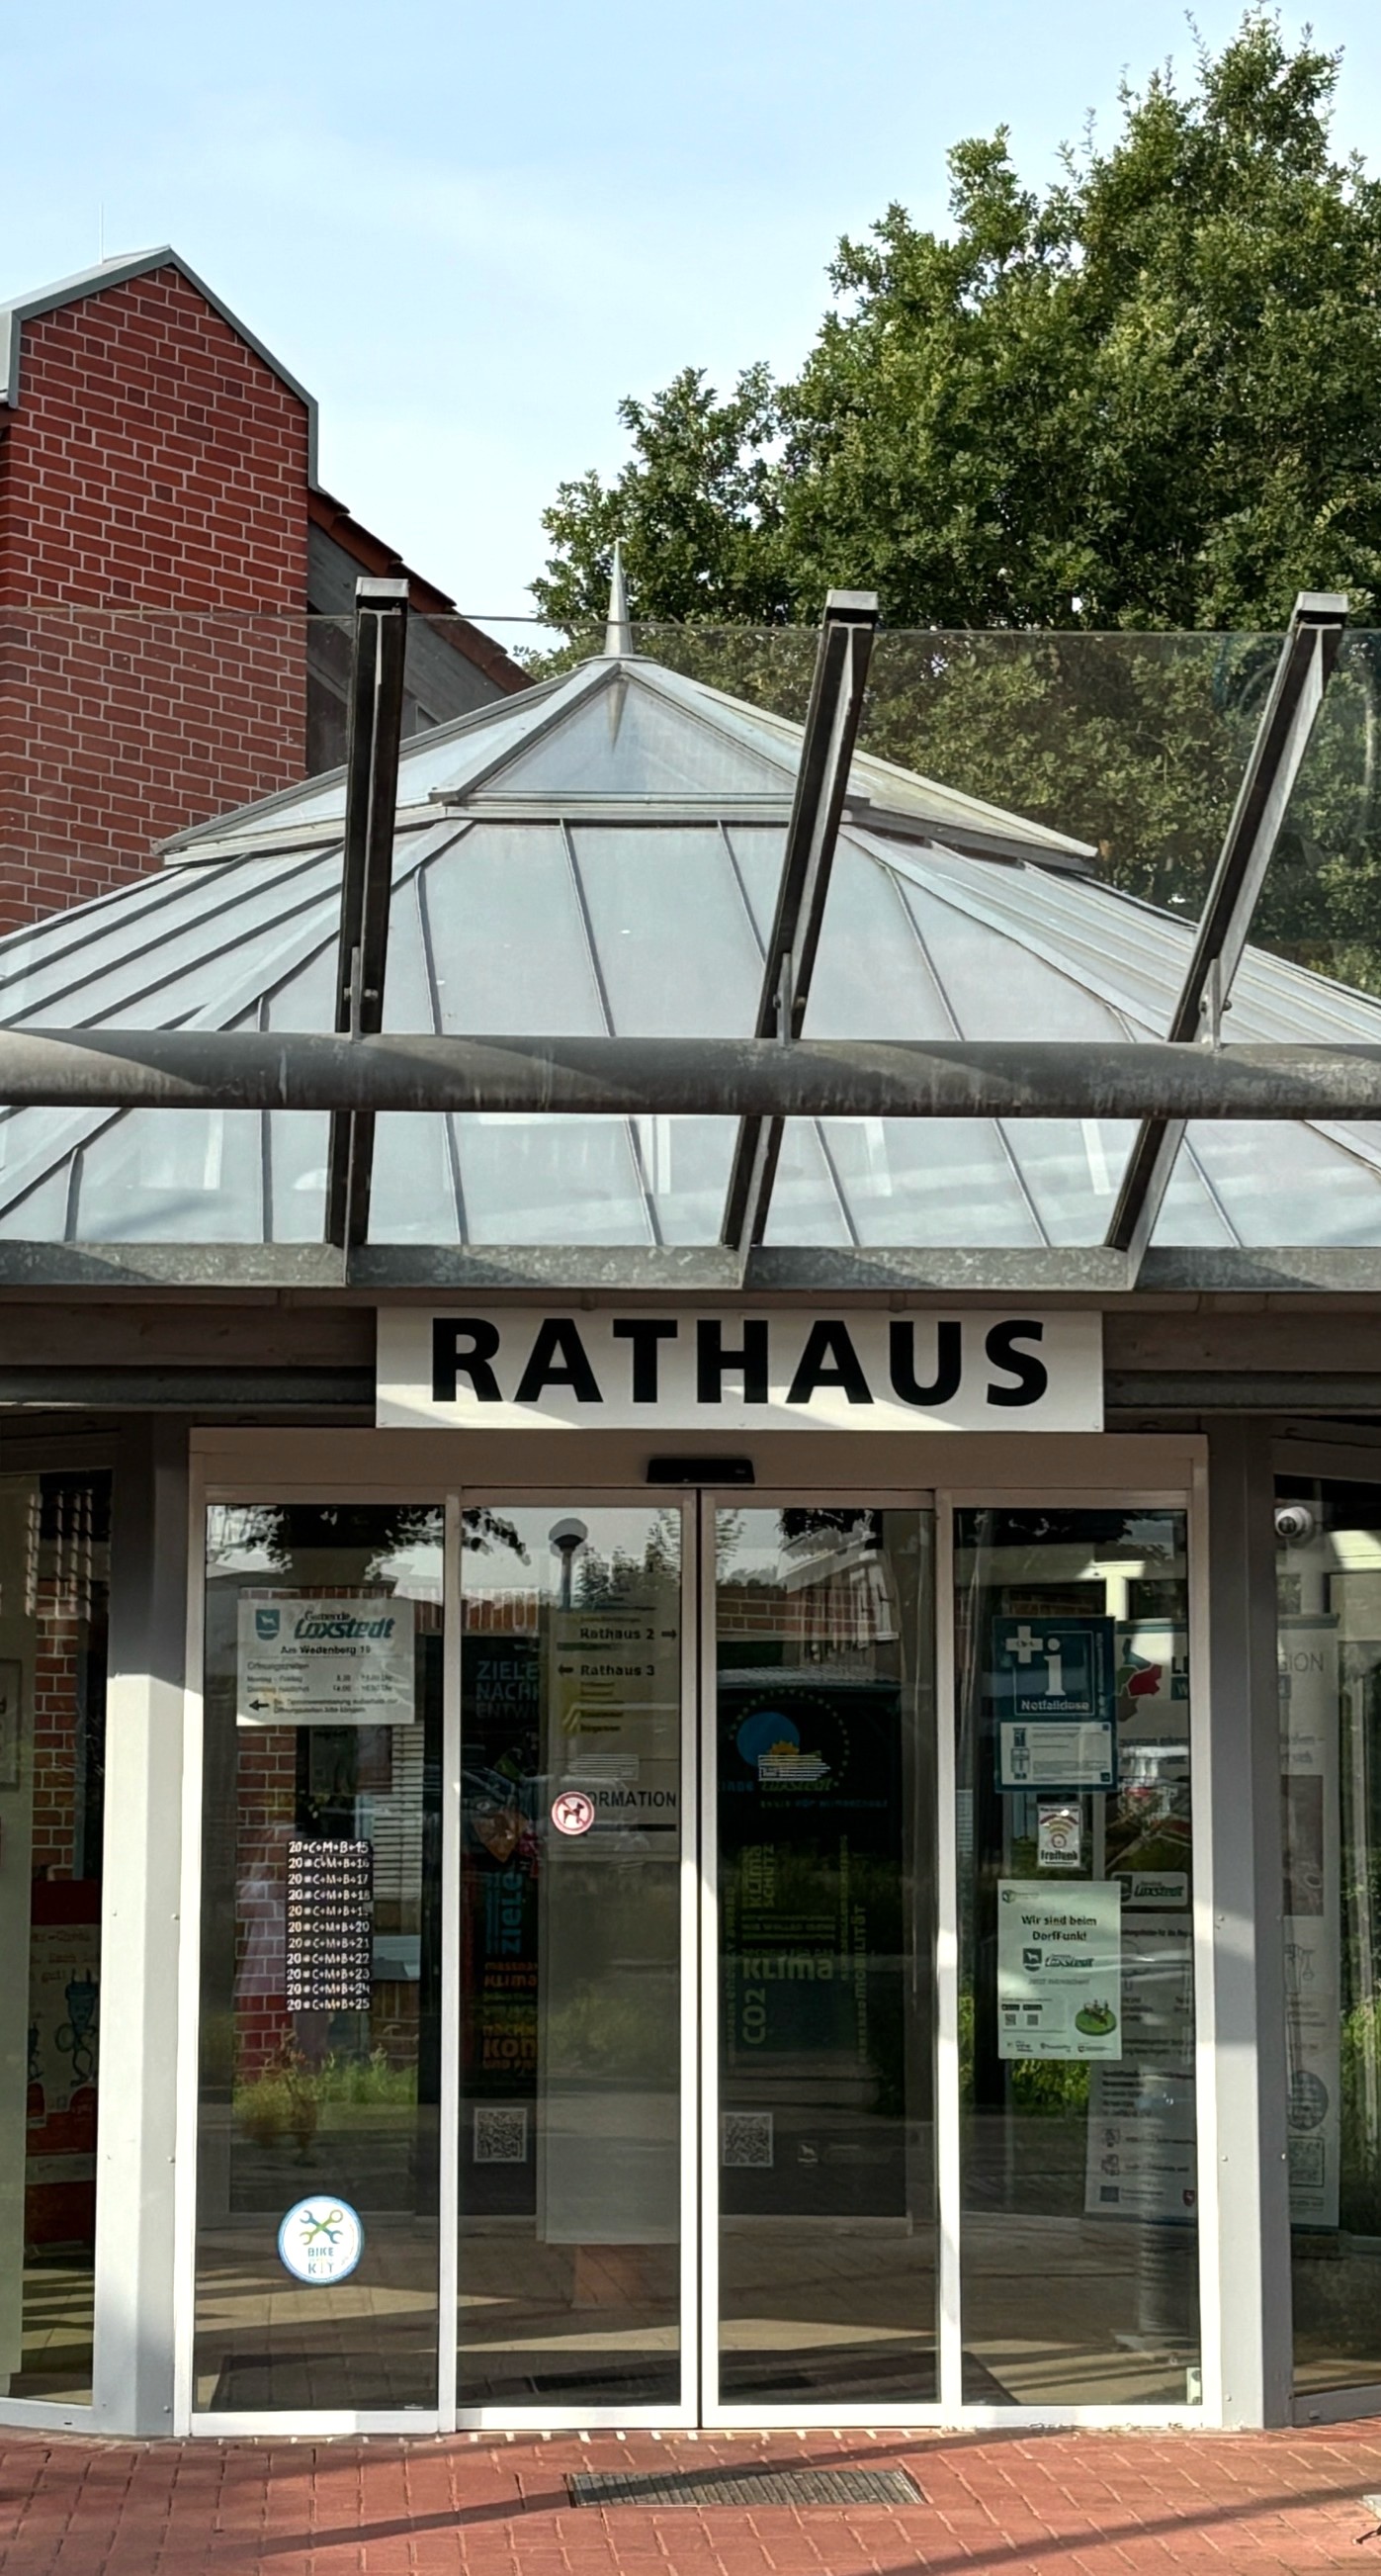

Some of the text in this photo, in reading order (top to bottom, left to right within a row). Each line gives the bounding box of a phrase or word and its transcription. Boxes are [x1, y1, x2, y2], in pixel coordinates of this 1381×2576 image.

[431, 1317, 1048, 1407] RATHAUS
[294, 1617, 395, 1640] Loxstedt
[580, 1628, 655, 1640] Rathaus 2
[476, 1660, 539, 1680] ZIELE
[580, 1664, 655, 1676] Rathaus 3
[1021, 1699, 1089, 1711] Notfalldose
[1021, 1914, 1097, 1926] Wir sind beim
[741, 1987, 766, 2045] CO2
[307, 2247, 335, 2258] BIKE
